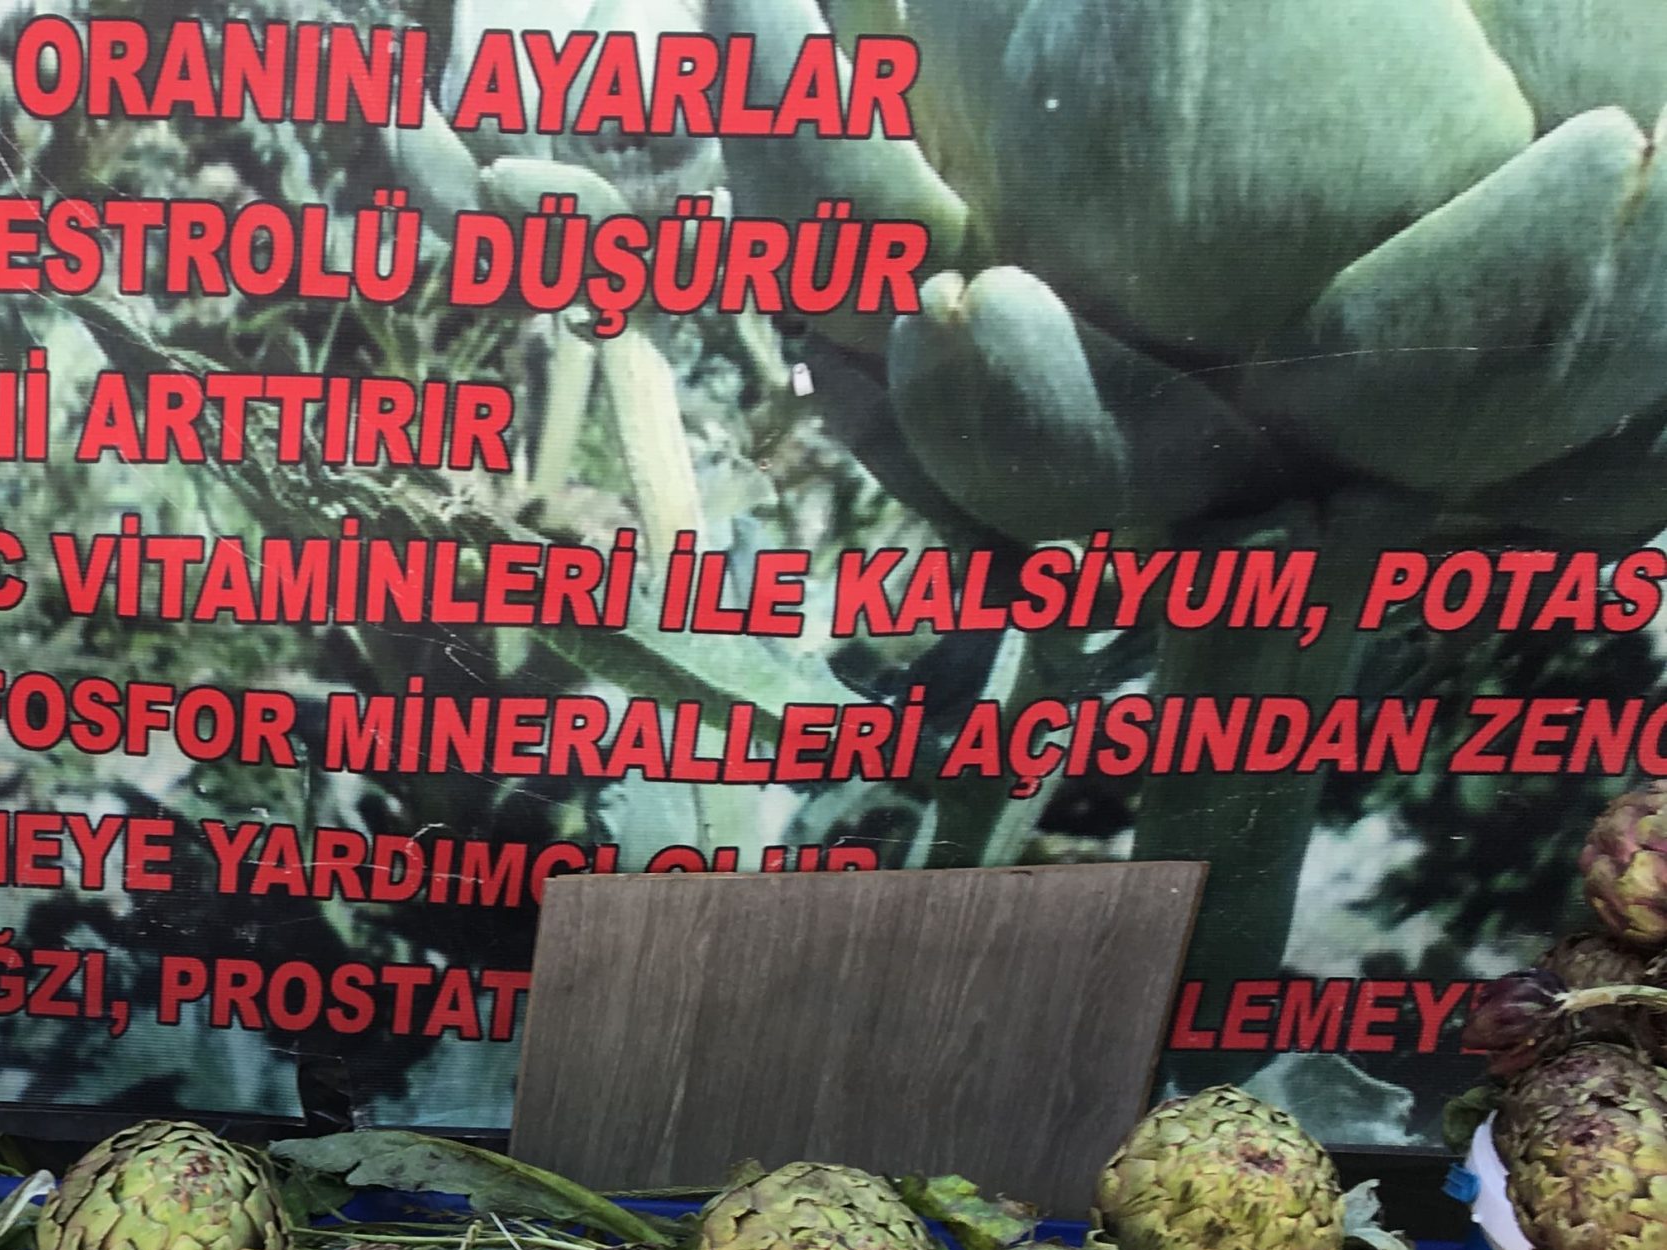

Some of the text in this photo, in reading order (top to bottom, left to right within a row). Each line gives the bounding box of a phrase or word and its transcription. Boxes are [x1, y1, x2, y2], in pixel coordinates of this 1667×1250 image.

[13, 16, 429, 128] ORANINI
[452, 31, 920, 139] AYARLAR
[448, 194, 930, 338] DÜŞÜRÜR
[75, 370, 515, 473] ARTTIRIR
[50, 513, 636, 629] VİTAMİNLERİ
[660, 530, 811, 637] İLE
[831, 529, 1329, 648] KALSİYUM,
[323, 674, 927, 784] MİNERALLERİ
[939, 695, 1440, 799] AÇISINDAN
[202, 819, 618, 909] YARDIM
[156, 952, 532, 1042] PROSTAT
[1168, 977, 1488, 1056] LEMEY
